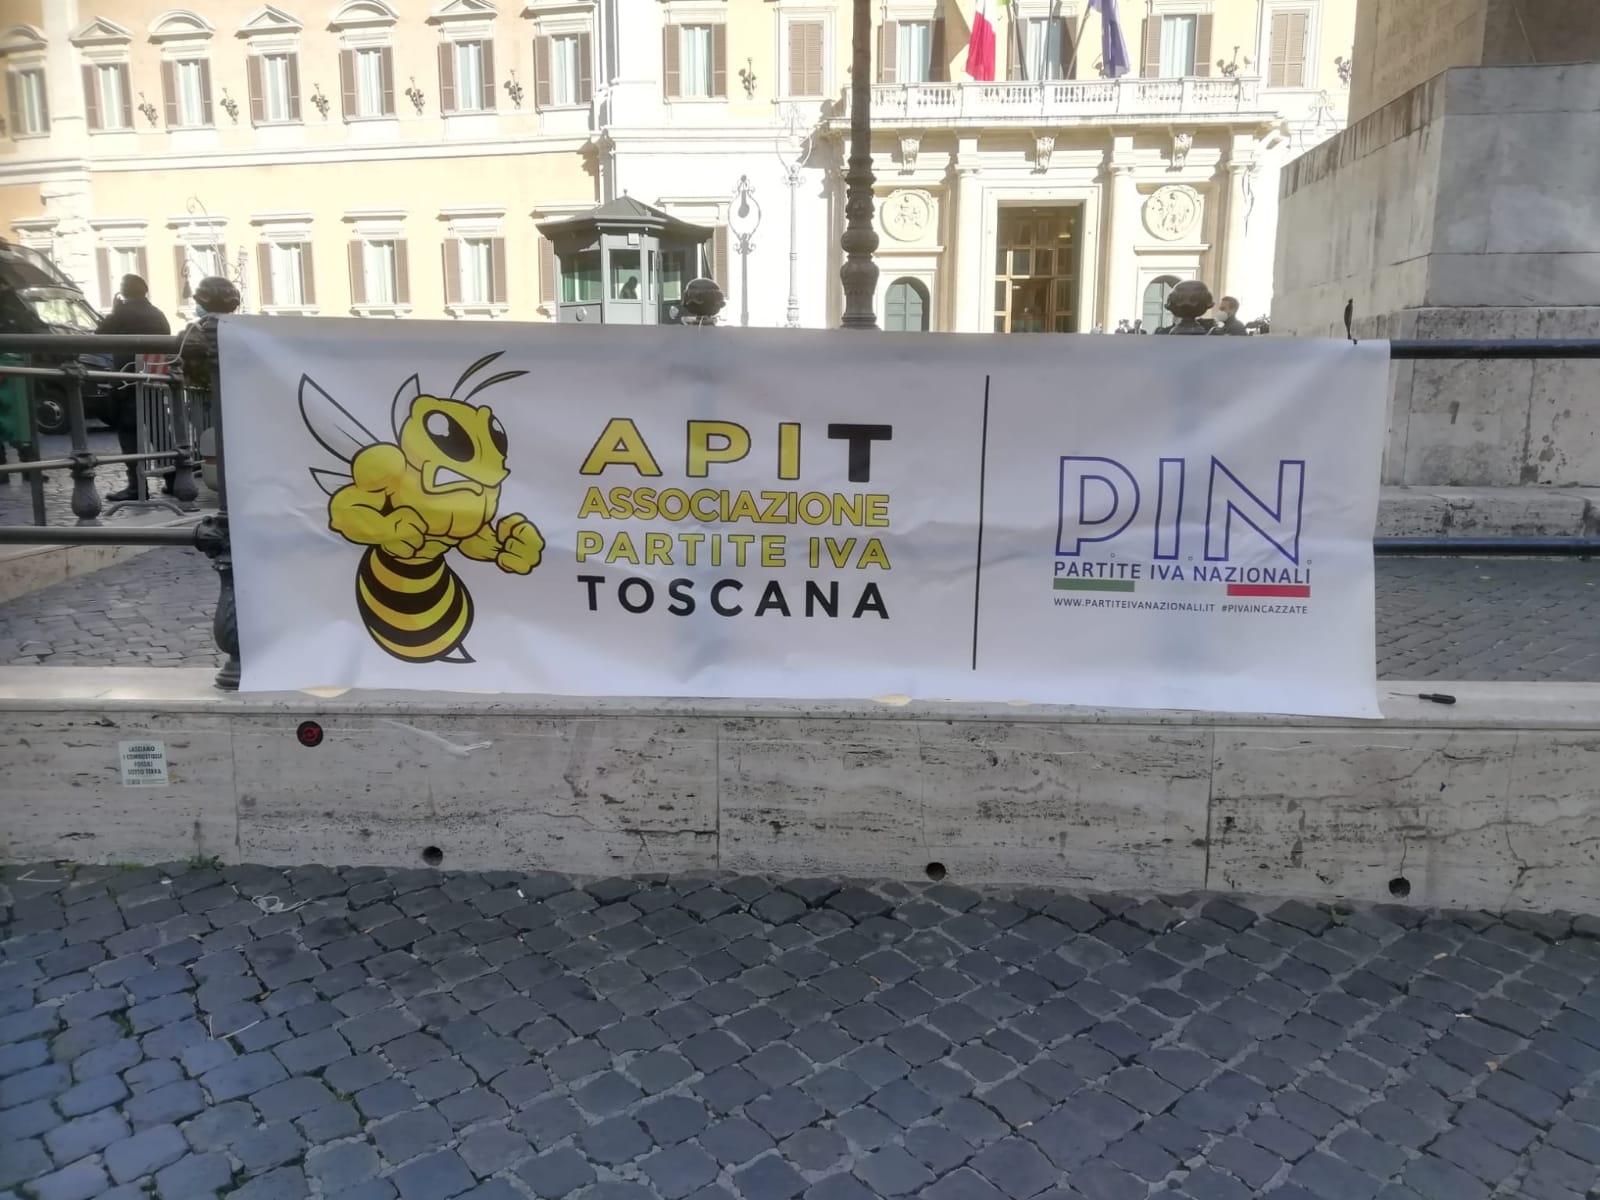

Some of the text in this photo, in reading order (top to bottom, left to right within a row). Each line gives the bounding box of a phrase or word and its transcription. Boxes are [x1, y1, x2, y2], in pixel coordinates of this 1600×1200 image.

[579, 417, 892, 483] APIT
[577, 486, 890, 527] ASSOCIAZIONE
[576, 530, 892, 570] PARTITE IVA
[1053, 561, 1311, 584] PARTITE IVA NAZIONALI
[577, 574, 890, 619] TOSCANA
[1053, 597, 1308, 615] WWW.PARTITEIVANAZIONALI.IT #PIVAINCAZZATE
